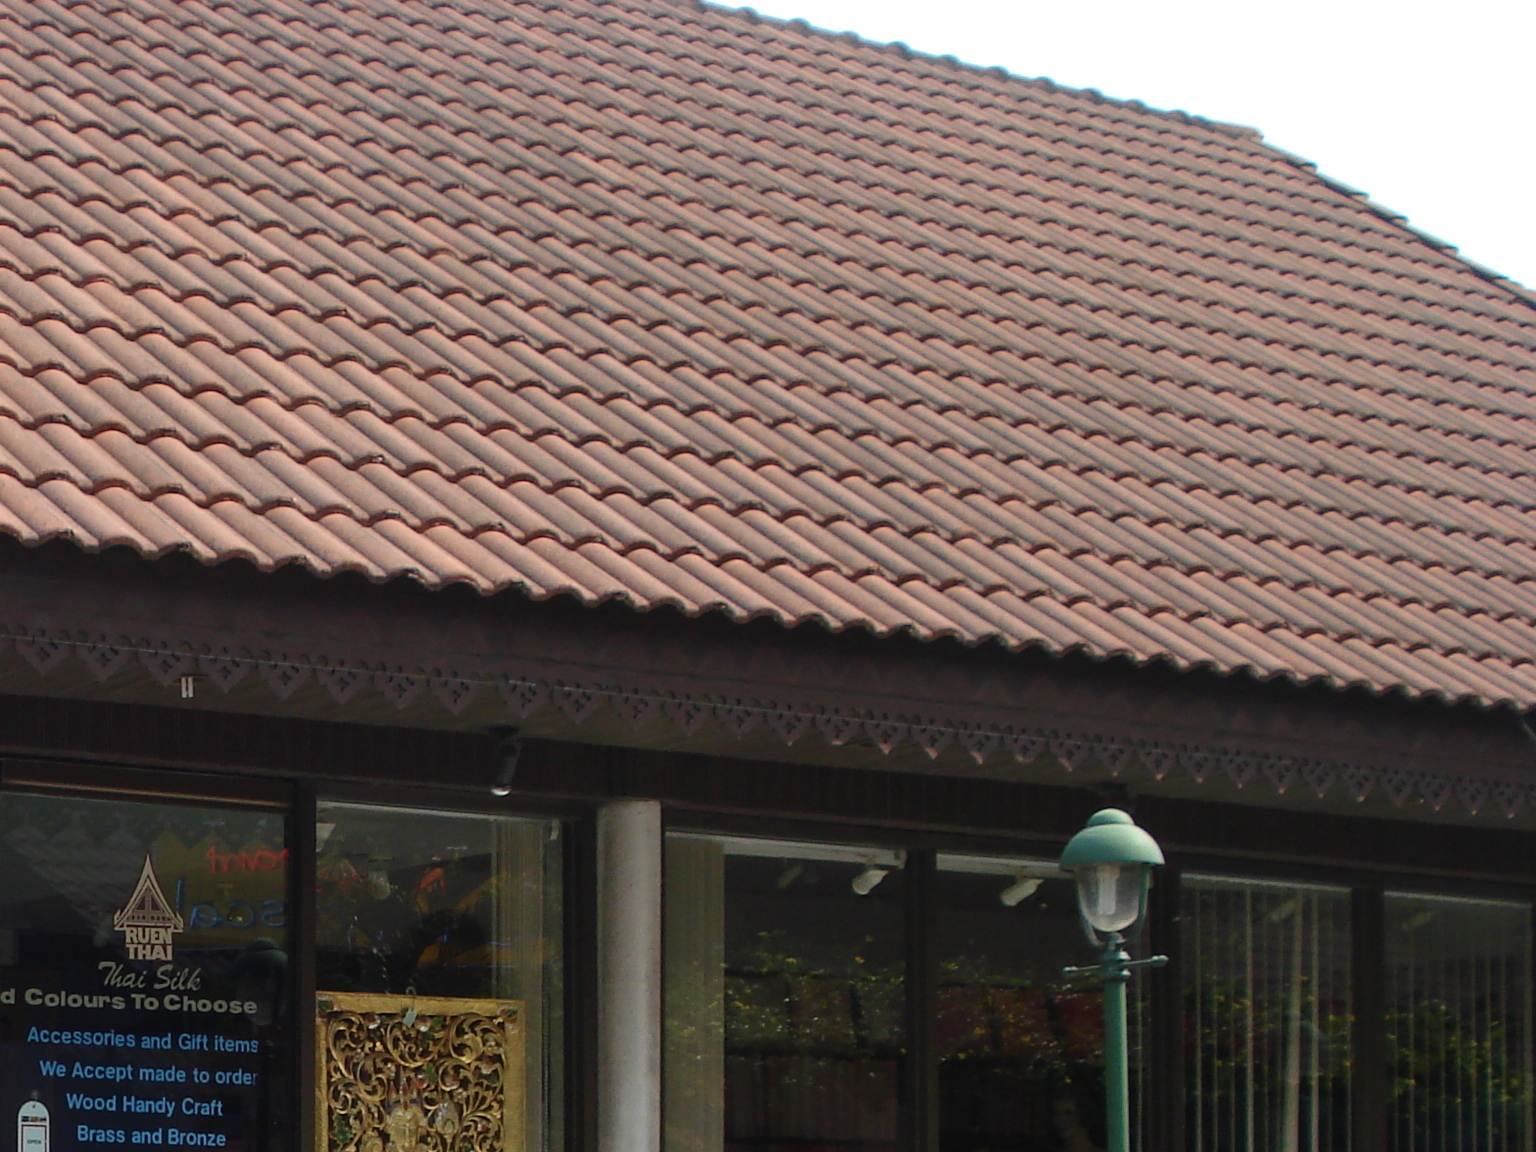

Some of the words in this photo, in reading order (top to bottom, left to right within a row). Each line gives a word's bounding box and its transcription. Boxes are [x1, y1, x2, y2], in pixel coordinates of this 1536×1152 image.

[125, 927, 172, 944] RUEN
[125, 944, 173, 961] THAI
[98, 961, 147, 989] Thai
[153, 964, 202, 991] Silk
[25, 988, 126, 1009] Colours
[131, 993, 159, 1011] To
[165, 994, 258, 1014] Choose
[27, 1026, 135, 1047] Accessories
[141, 1033, 171, 1050] and
[178, 1033, 208, 1051] Gift
[214, 1035, 258, 1053] items
[39, 1060, 66, 1077] We
[72, 1061, 133, 1082] Accept
[139, 1065, 186, 1083] made
[193, 1067, 210, 1083] to
[215, 1068, 257, 1085] order
[66, 1093, 116, 1112] Wood
[122, 1095, 175, 1117] Handy
[182, 1097, 223, 1116] Craft
[77, 1125, 125, 1143] Brass
[132, 1128, 162, 1145] and
[167, 1129, 227, 1146] Bronze
